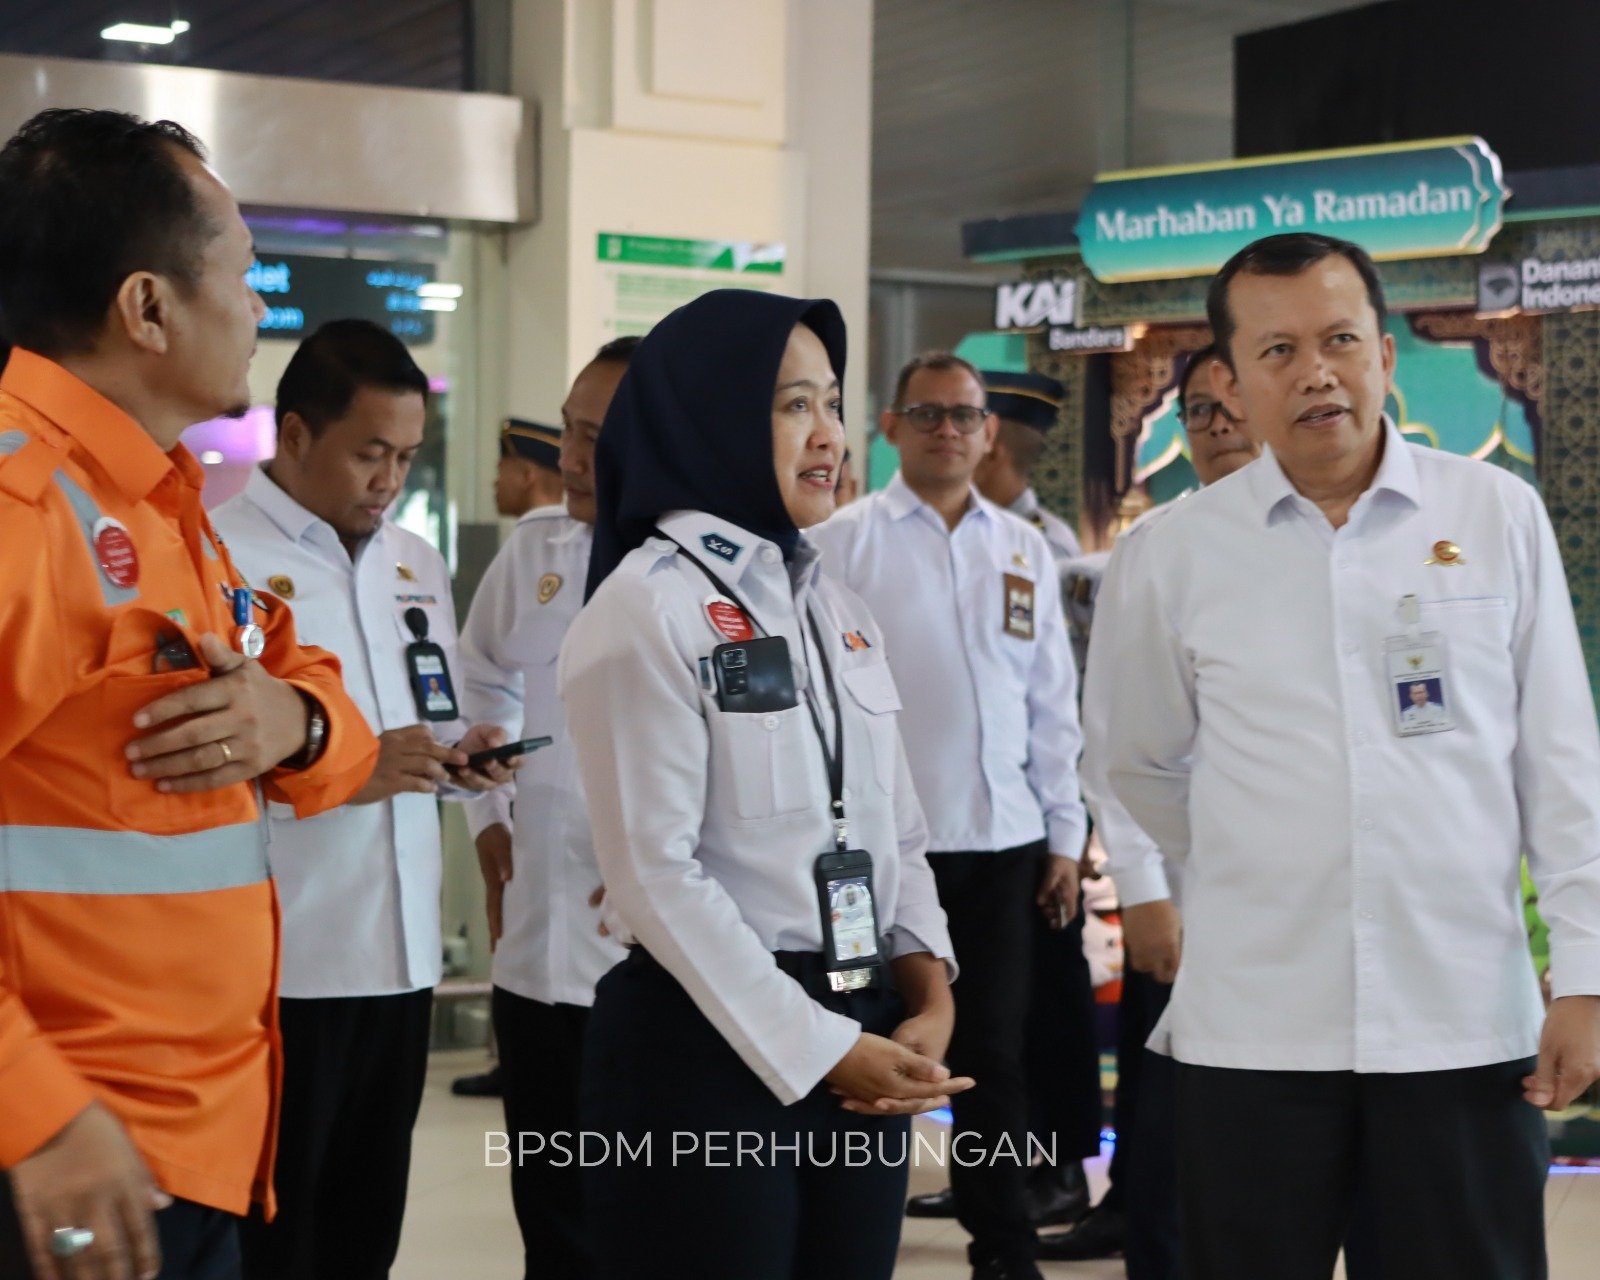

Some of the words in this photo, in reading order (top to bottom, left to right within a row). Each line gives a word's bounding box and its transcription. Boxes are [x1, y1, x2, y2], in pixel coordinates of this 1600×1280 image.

[1095, 202, 1256, 242] Marhaban
[1262, 194, 1305, 228] Ya
[1314, 181, 1472, 223] Ramadan
[1521, 258, 1600, 285] Danan
[995, 279, 1076, 329] KAI
[1049, 328, 1124, 350] Bandara
